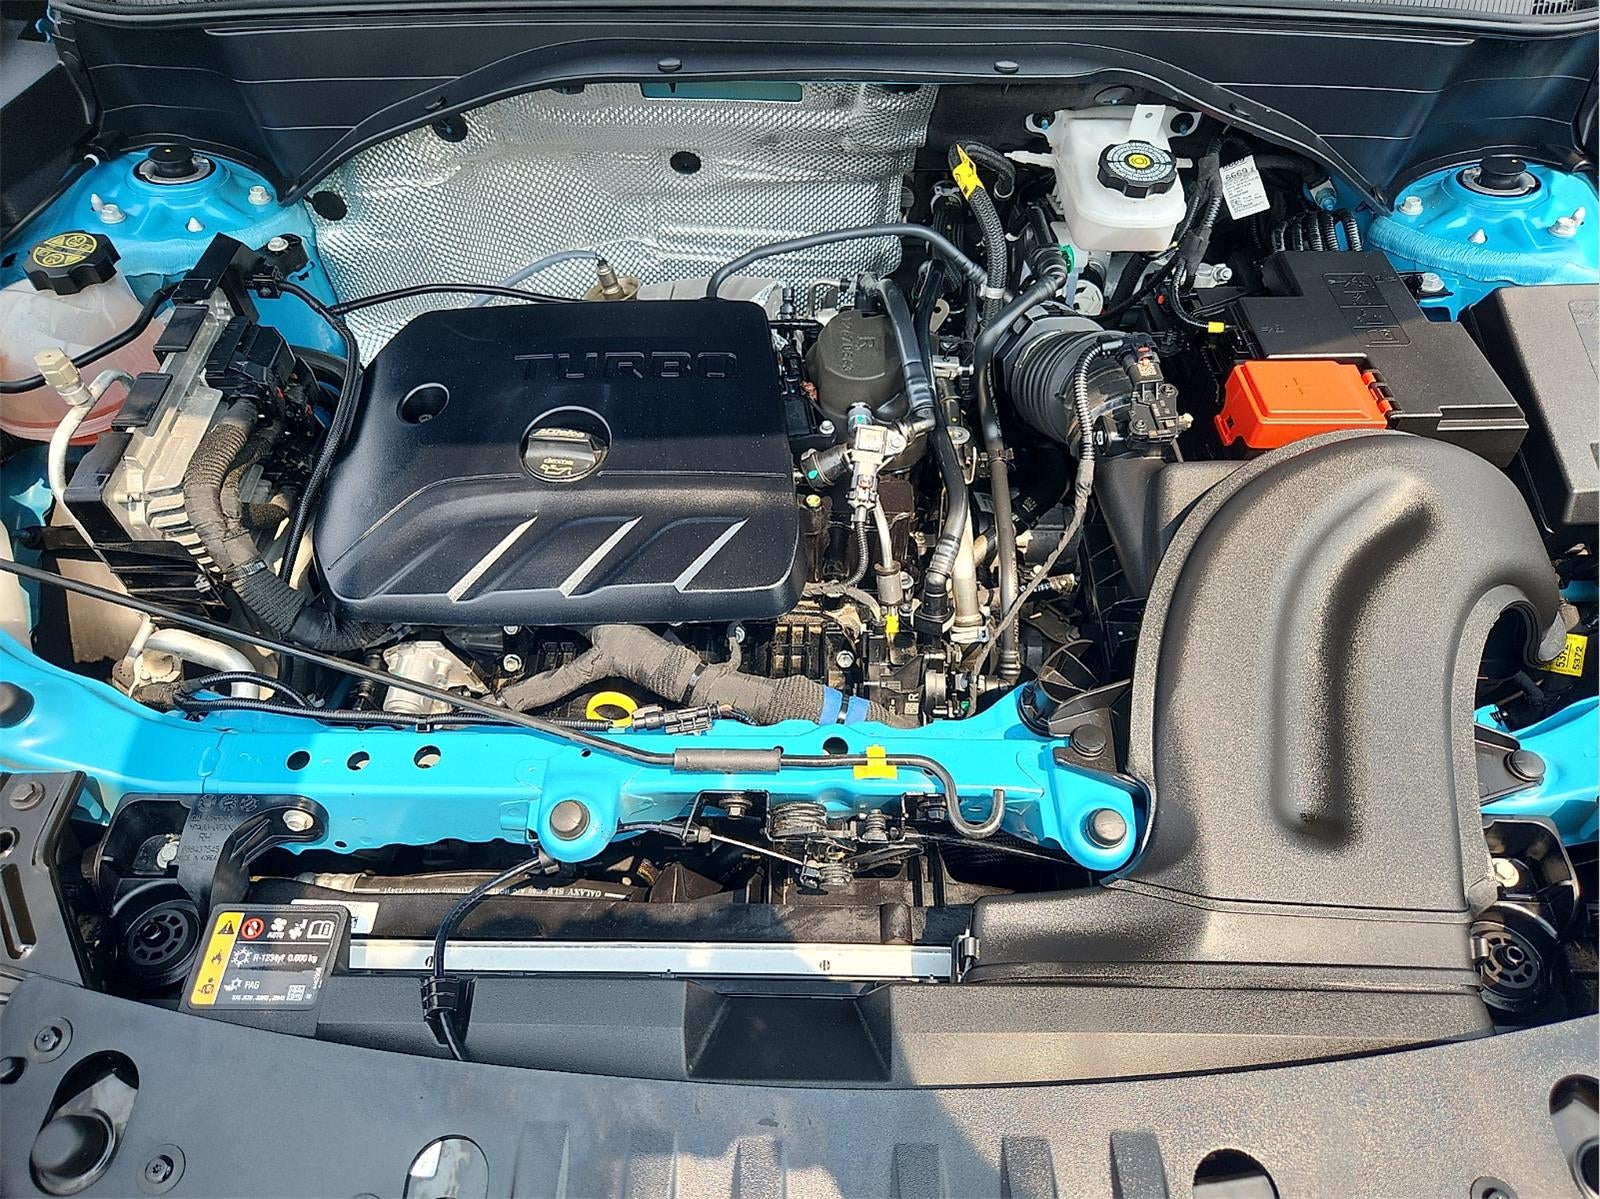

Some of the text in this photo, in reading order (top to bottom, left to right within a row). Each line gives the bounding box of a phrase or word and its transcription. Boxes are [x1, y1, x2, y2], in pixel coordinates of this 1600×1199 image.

[514, 351, 738, 380] TURBO
[1571, 646, 1583, 671] 5372
[567, 887, 602, 898] GALAXY
[266, 931, 285, 939] AUTO
[308, 953, 319, 964] kg
[244, 980, 261, 990] PAG
